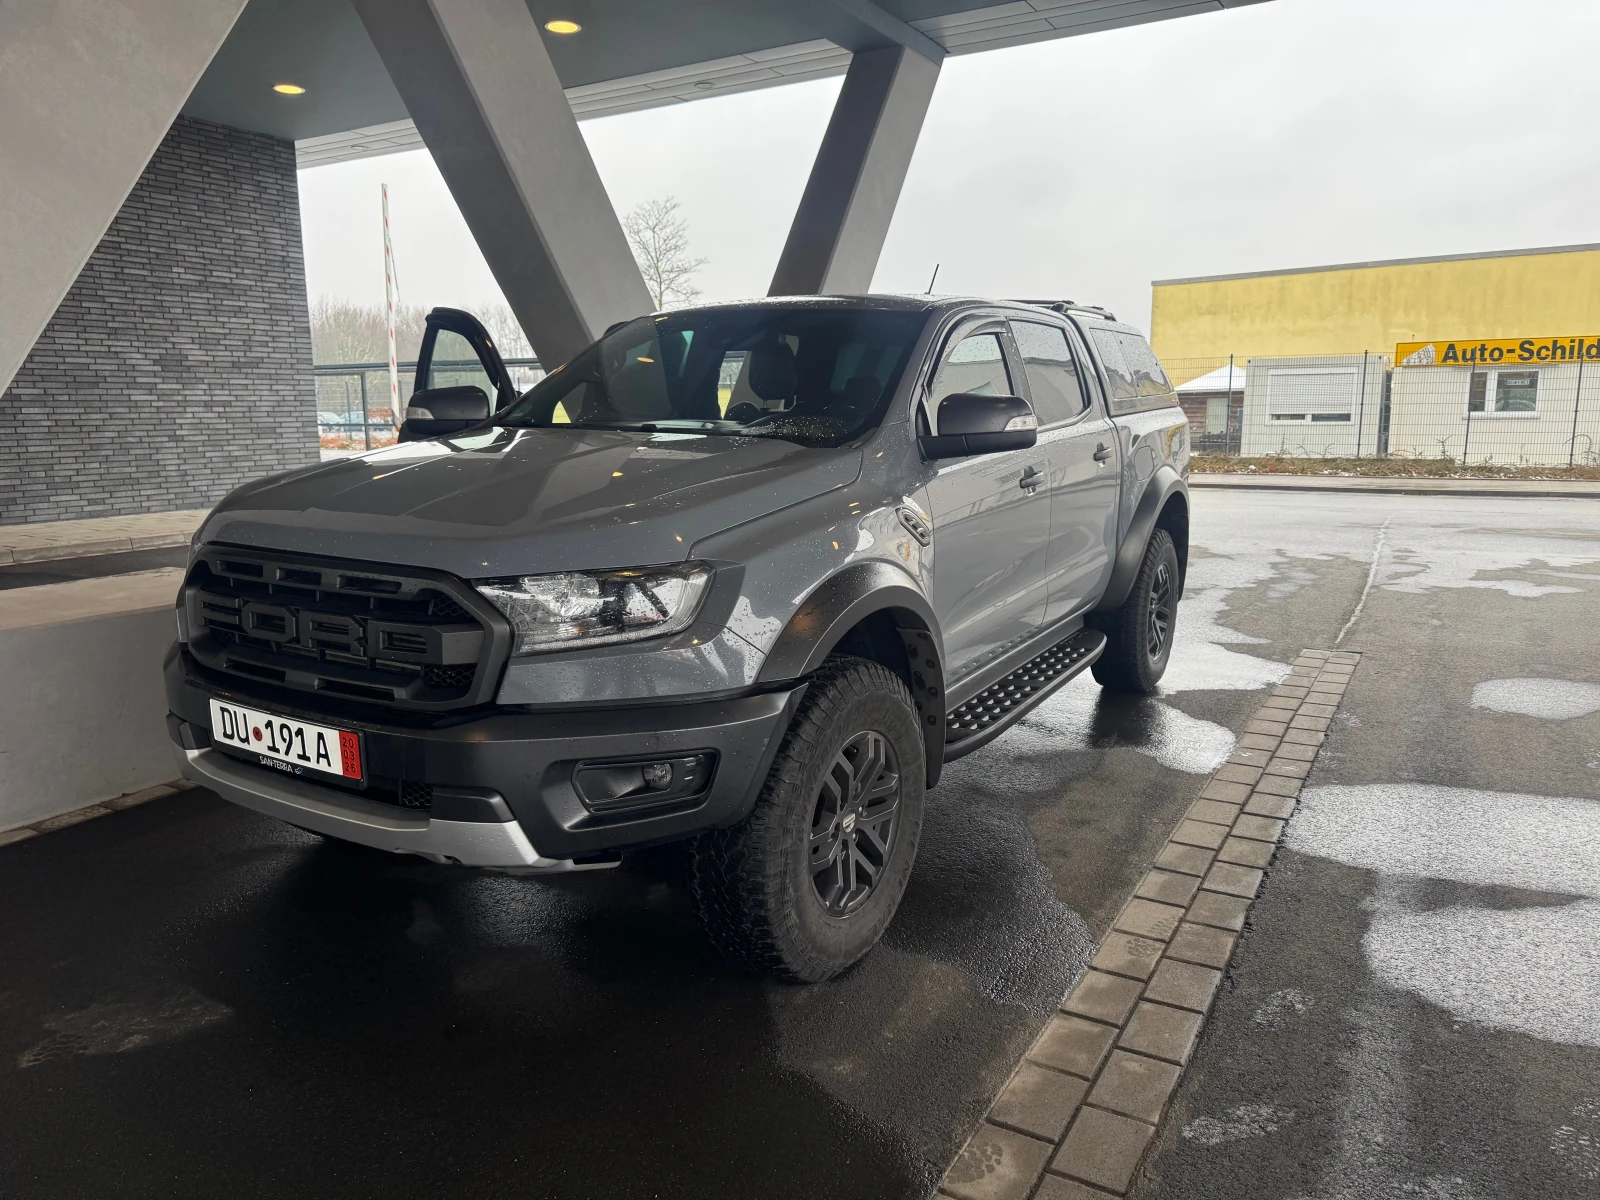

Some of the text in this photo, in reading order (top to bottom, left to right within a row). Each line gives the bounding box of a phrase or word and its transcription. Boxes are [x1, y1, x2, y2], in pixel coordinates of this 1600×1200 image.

[1441, 338, 1600, 363] Auto-Schild
[196, 590, 444, 665] FORD
[219, 706, 332, 767] DU 191A
[342, 737, 354, 748] 20
[343, 749, 355, 761] 03
[345, 761, 357, 773] 26
